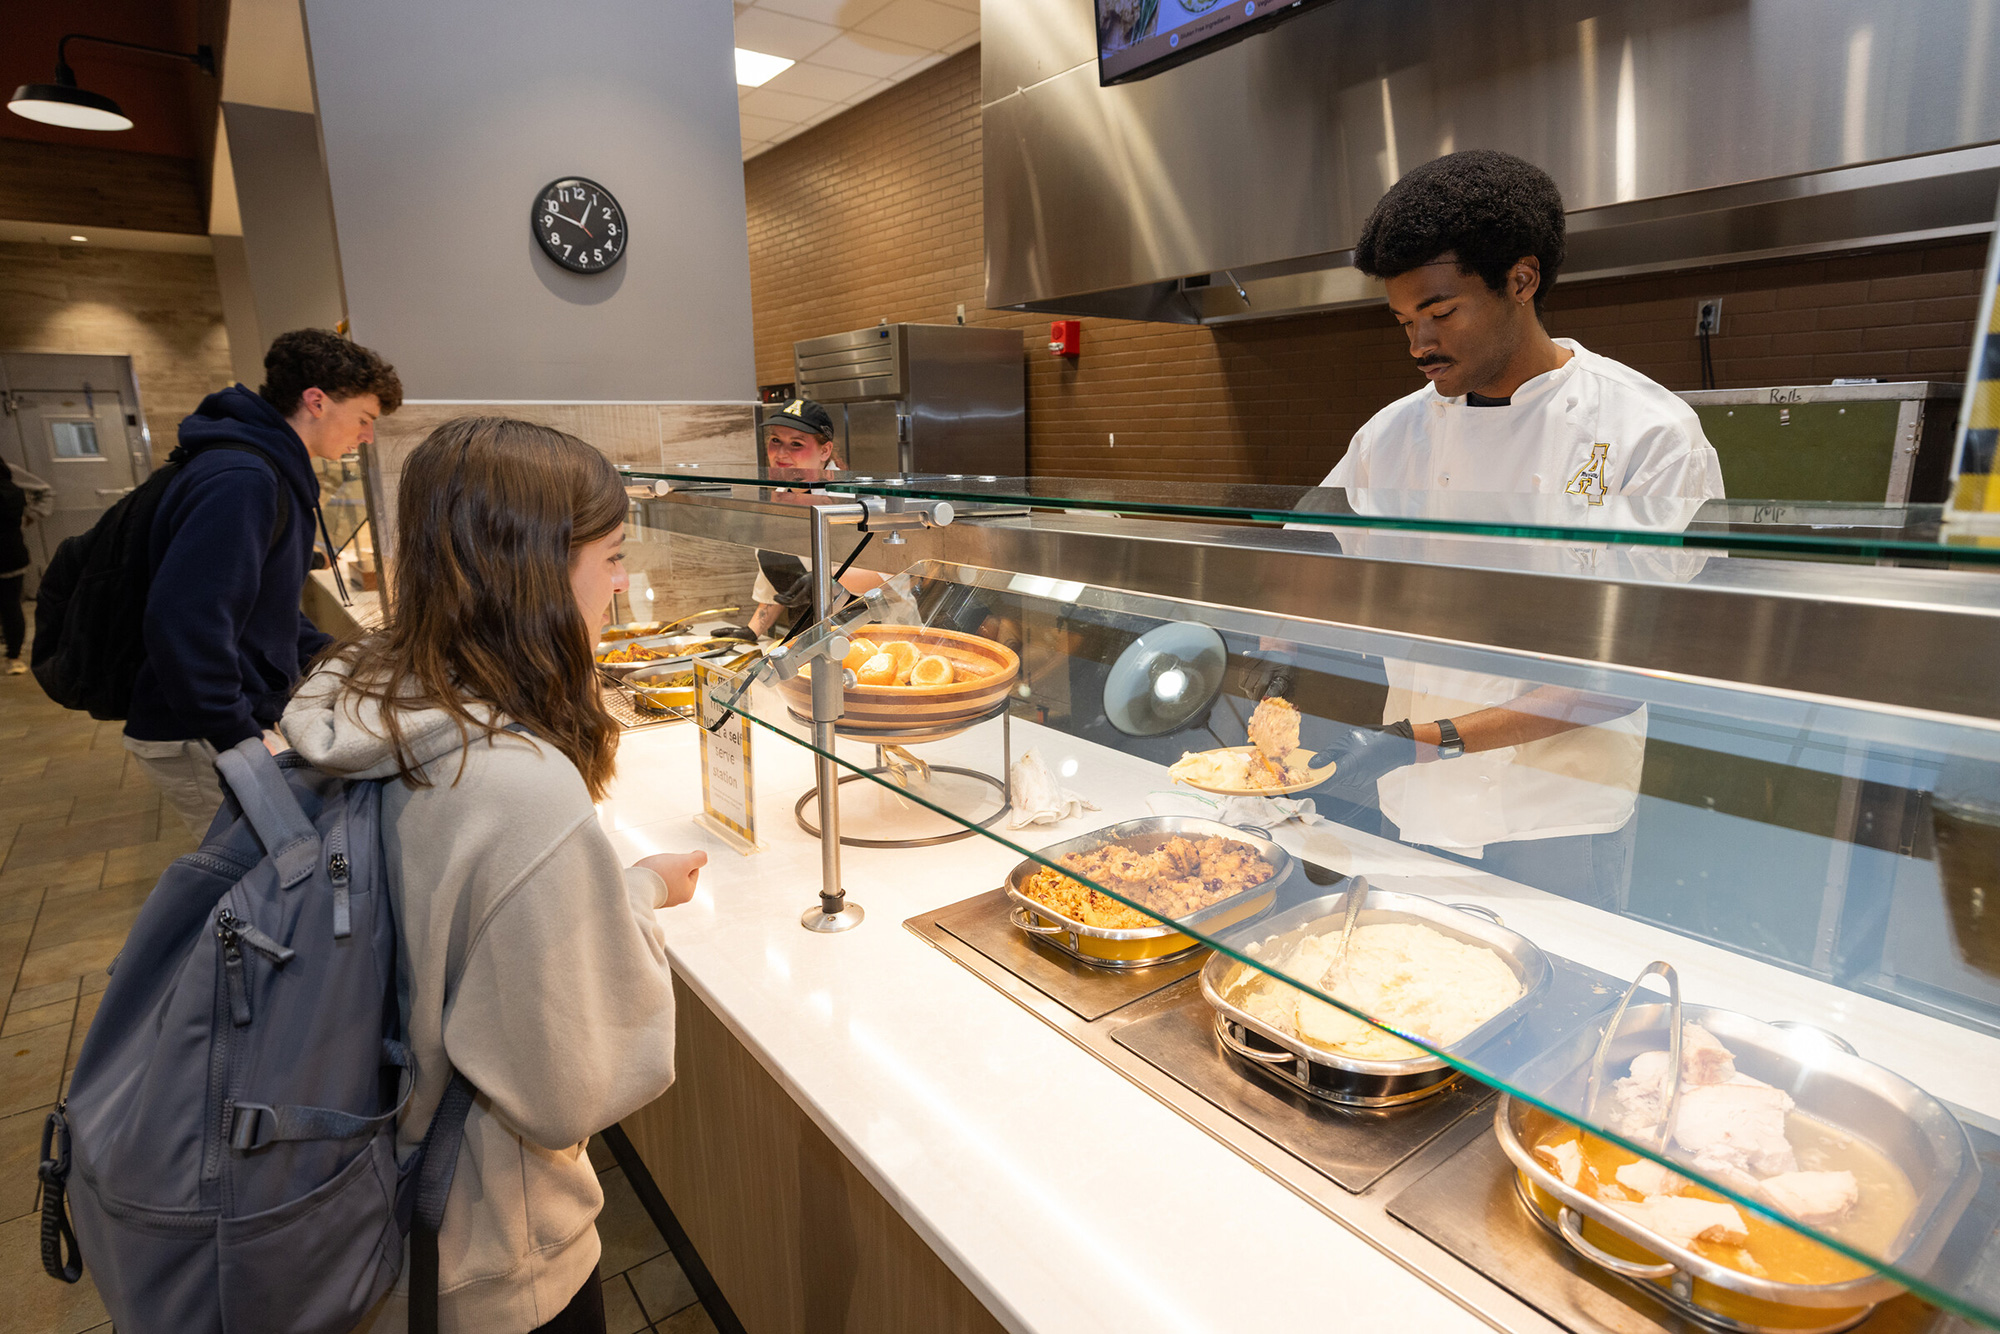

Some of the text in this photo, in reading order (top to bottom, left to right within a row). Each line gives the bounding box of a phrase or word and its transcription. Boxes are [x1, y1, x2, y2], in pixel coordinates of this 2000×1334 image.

[559, 189, 570, 203] 11
[572, 187, 585, 200] 12
[592, 194, 597, 206] 1
[547, 200, 560, 213] 10
[602, 207, 612, 220] 2
[544, 214, 554, 228] 9
[607, 223, 617, 236] 3
[551, 232, 561, 245] 8
[563, 244, 573, 258] 7
[604, 239, 613, 252] 4
[579, 251, 588, 264] 6
[593, 249, 603, 262] 5
[783, 399, 804, 417] A
[1565, 443, 1610, 506] A
[723, 728, 728, 739] a
[715, 746, 735, 765] serve
[712, 766, 738, 789] station
